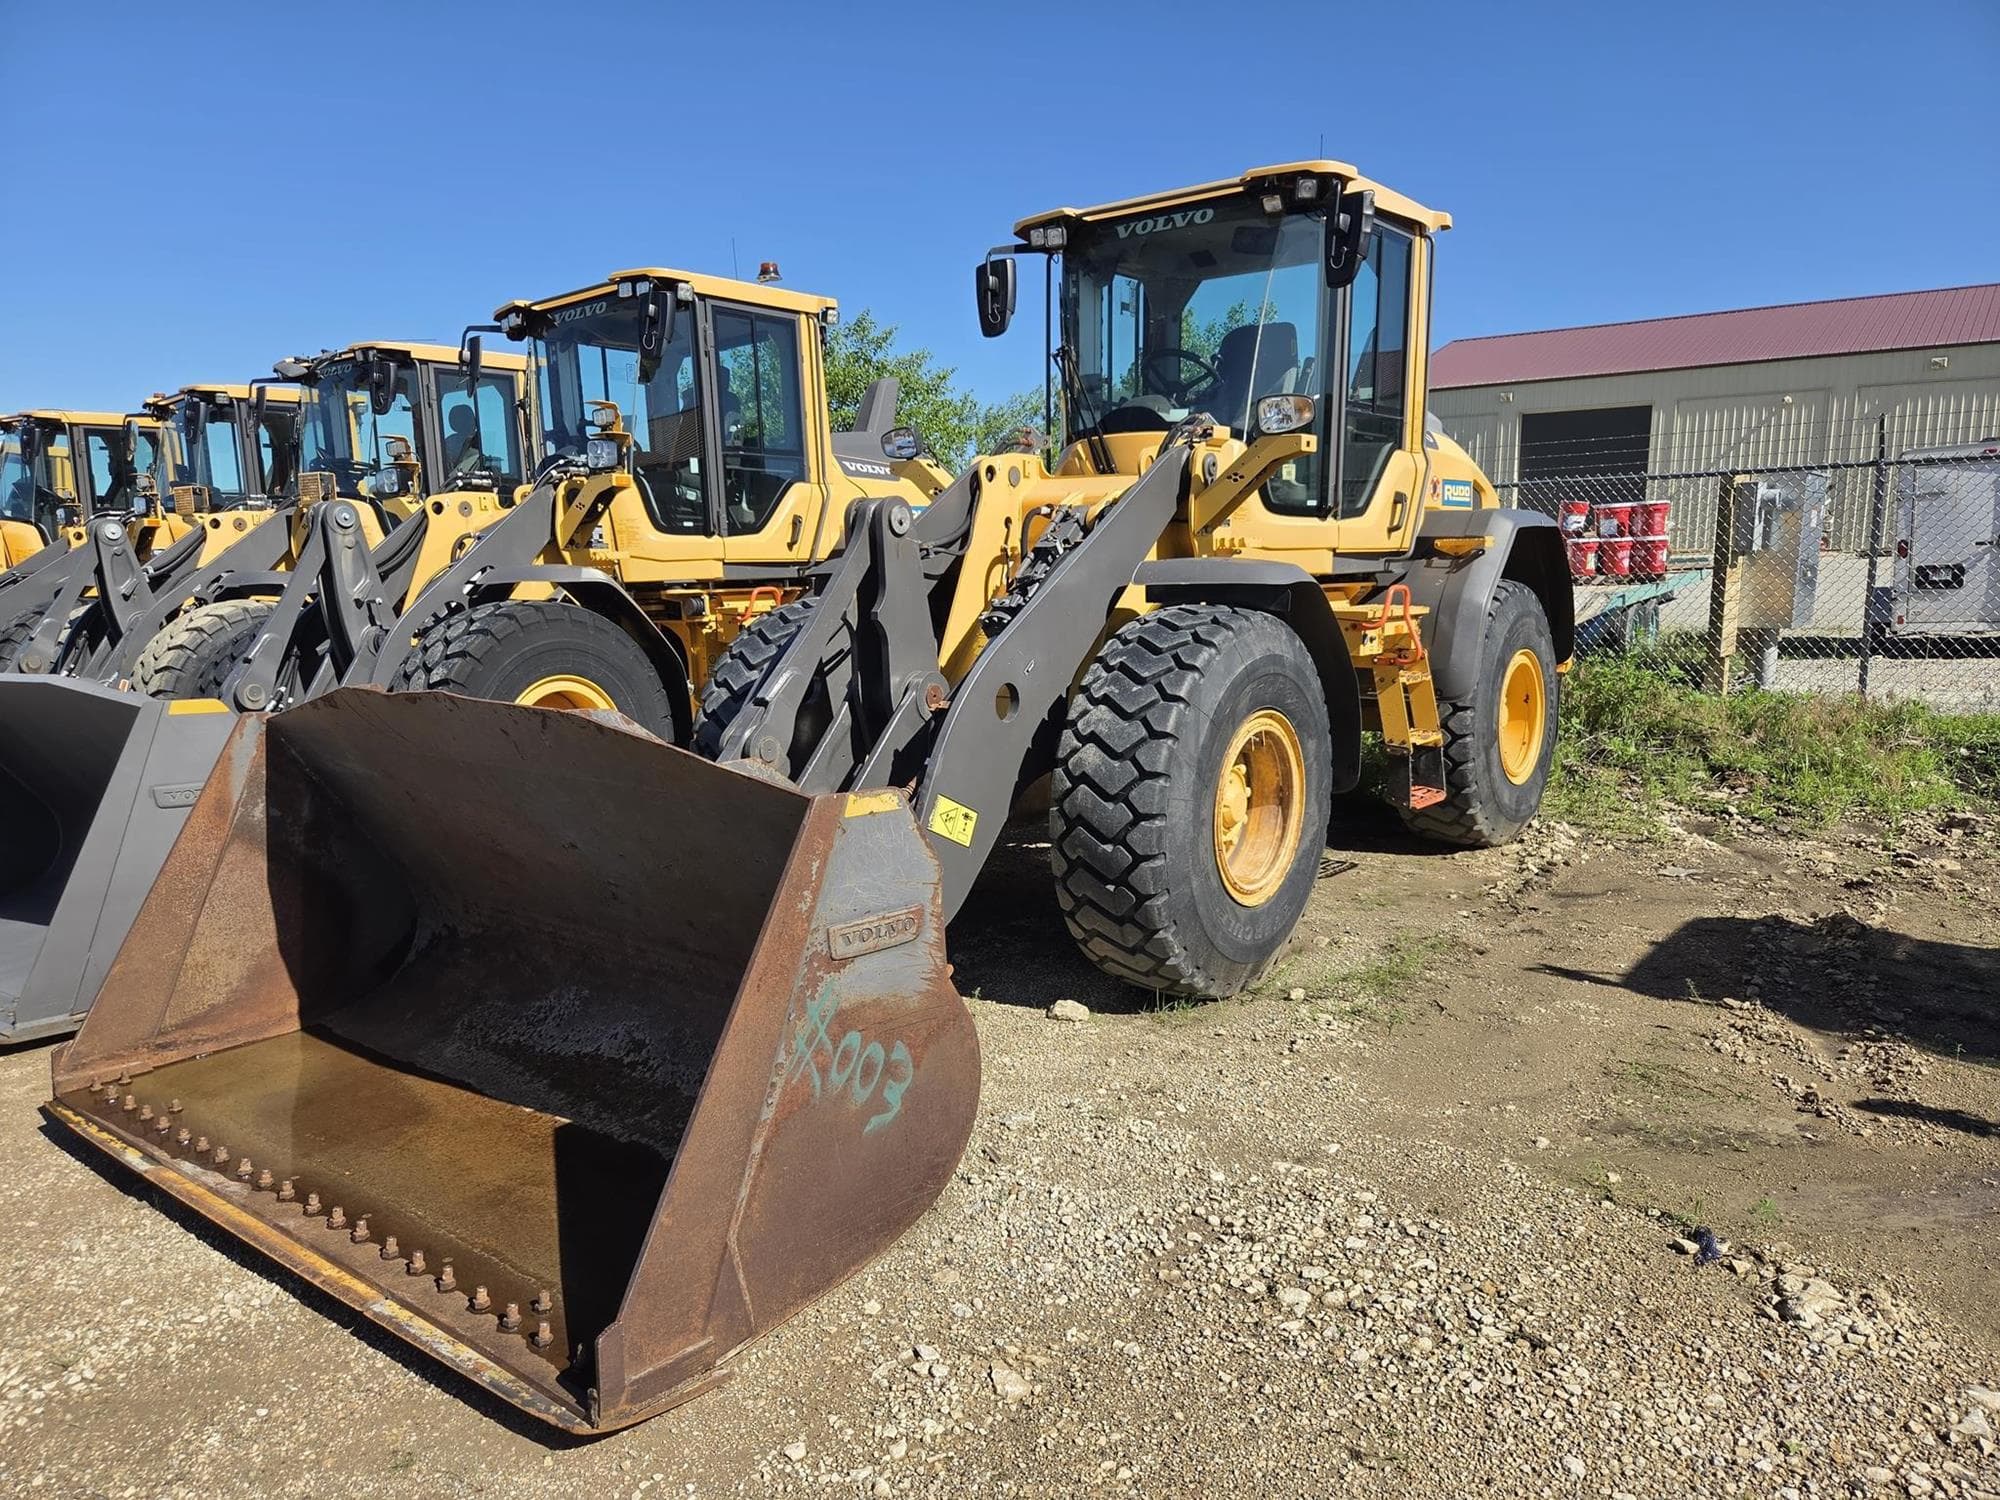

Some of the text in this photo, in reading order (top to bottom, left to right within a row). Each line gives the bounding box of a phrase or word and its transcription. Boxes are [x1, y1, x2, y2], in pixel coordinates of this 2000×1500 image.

[1115, 207, 1215, 239] VOLVO
[553, 301, 608, 325] VOLVO
[840, 916, 916, 947] VOLVO
